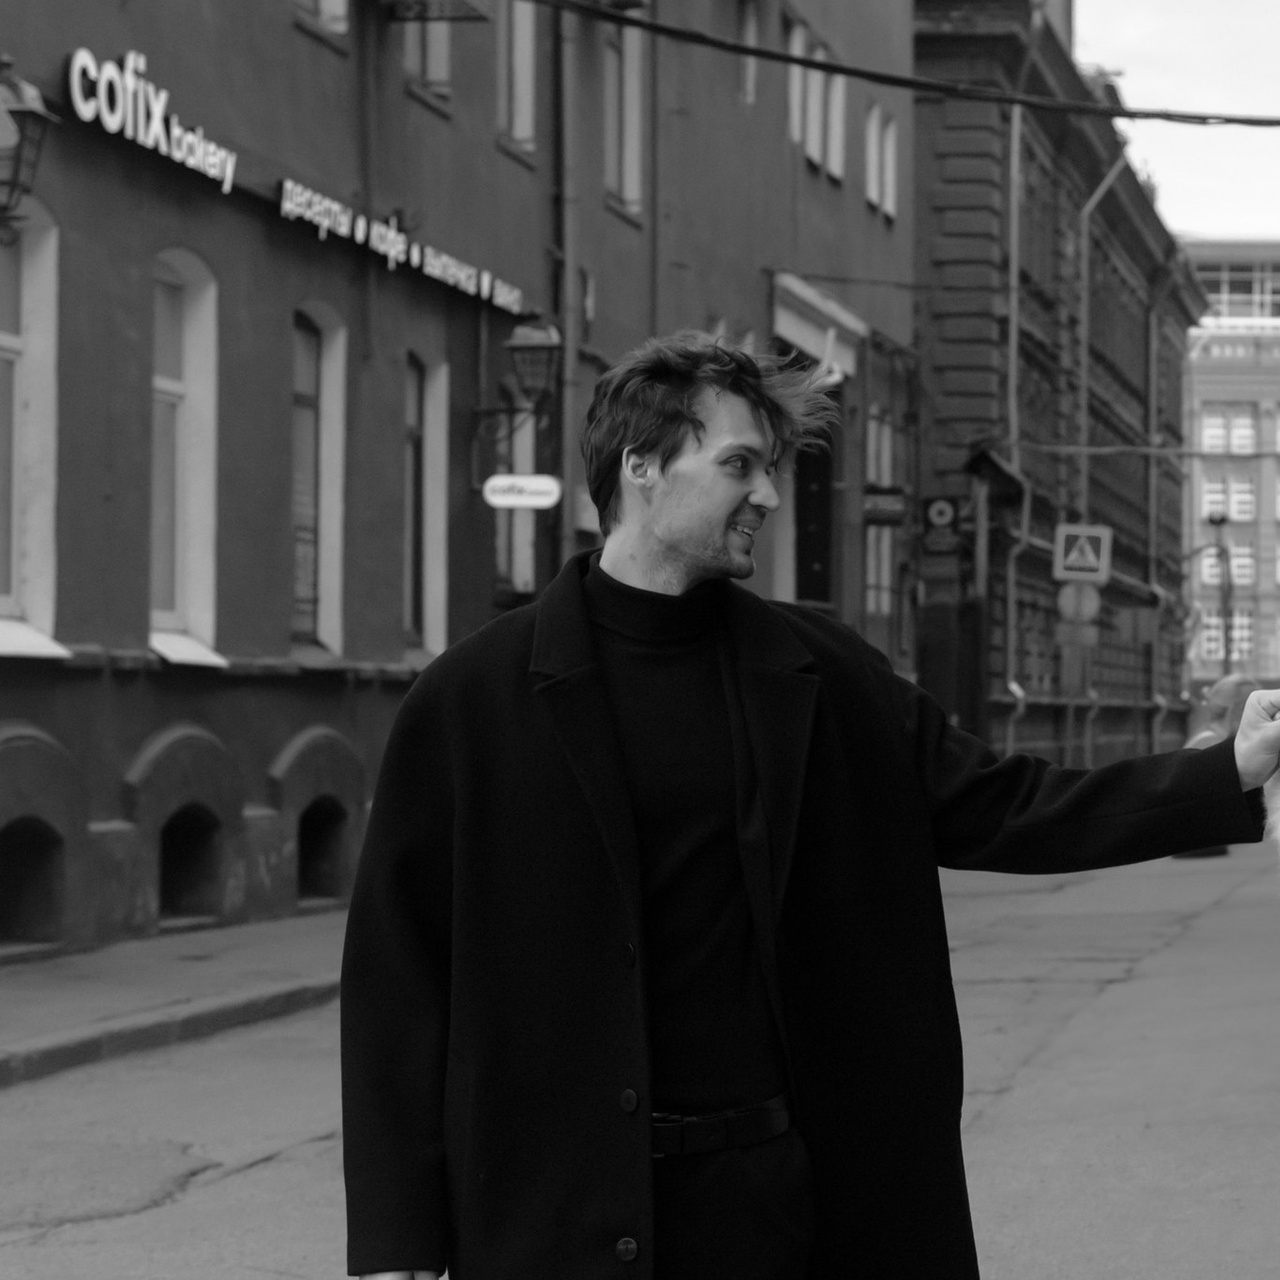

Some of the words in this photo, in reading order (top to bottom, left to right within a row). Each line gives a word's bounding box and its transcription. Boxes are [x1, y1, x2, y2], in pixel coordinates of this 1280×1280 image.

[69, 47, 169, 156] cofix
[169, 113, 237, 195] bakery
[281, 178, 353, 241] десерты
